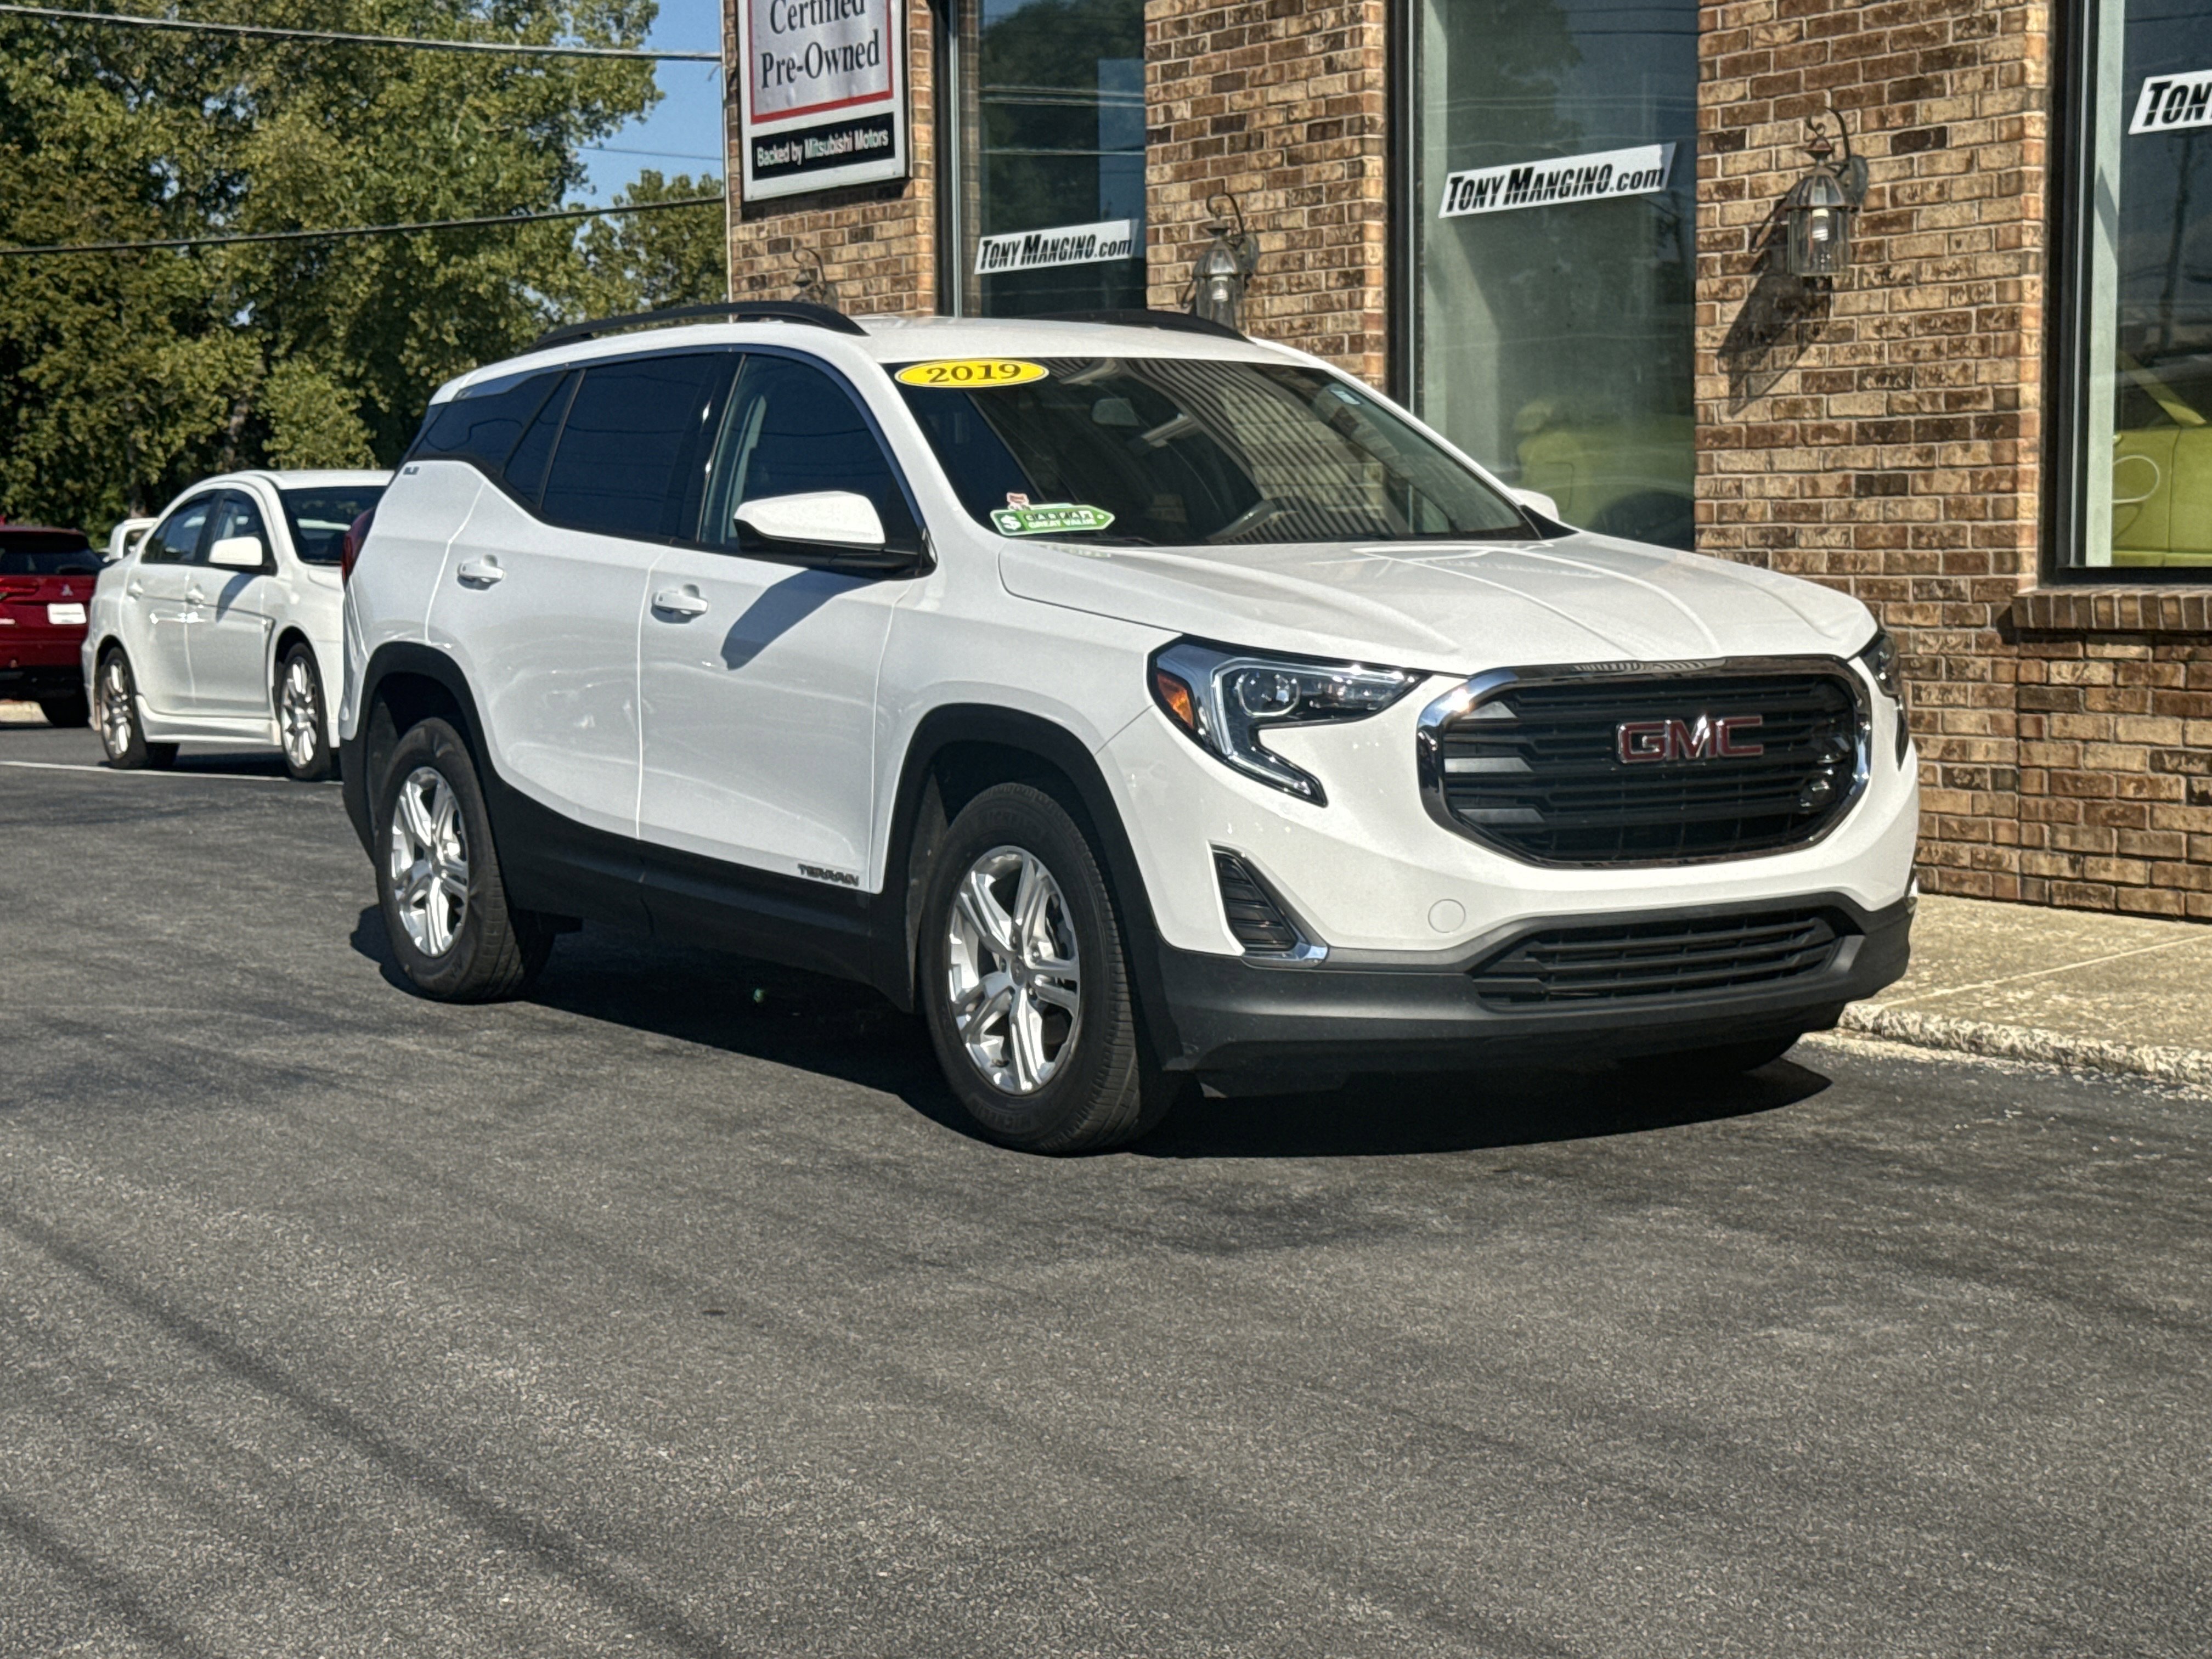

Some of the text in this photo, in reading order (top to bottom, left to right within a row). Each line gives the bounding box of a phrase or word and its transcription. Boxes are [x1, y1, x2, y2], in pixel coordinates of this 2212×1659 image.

[761, 29, 880, 88] Pre-Owned
[2142, 80, 2212, 127] TON
[757, 128, 889, 167] Backed by Mitsubishi Motors
[1446, 165, 1665, 213] TONY MANGINO.com
[980, 234, 1132, 270] TONY MANGINO.com
[926, 364, 1021, 383] 2019
[1616, 714, 1763, 763] GMC
